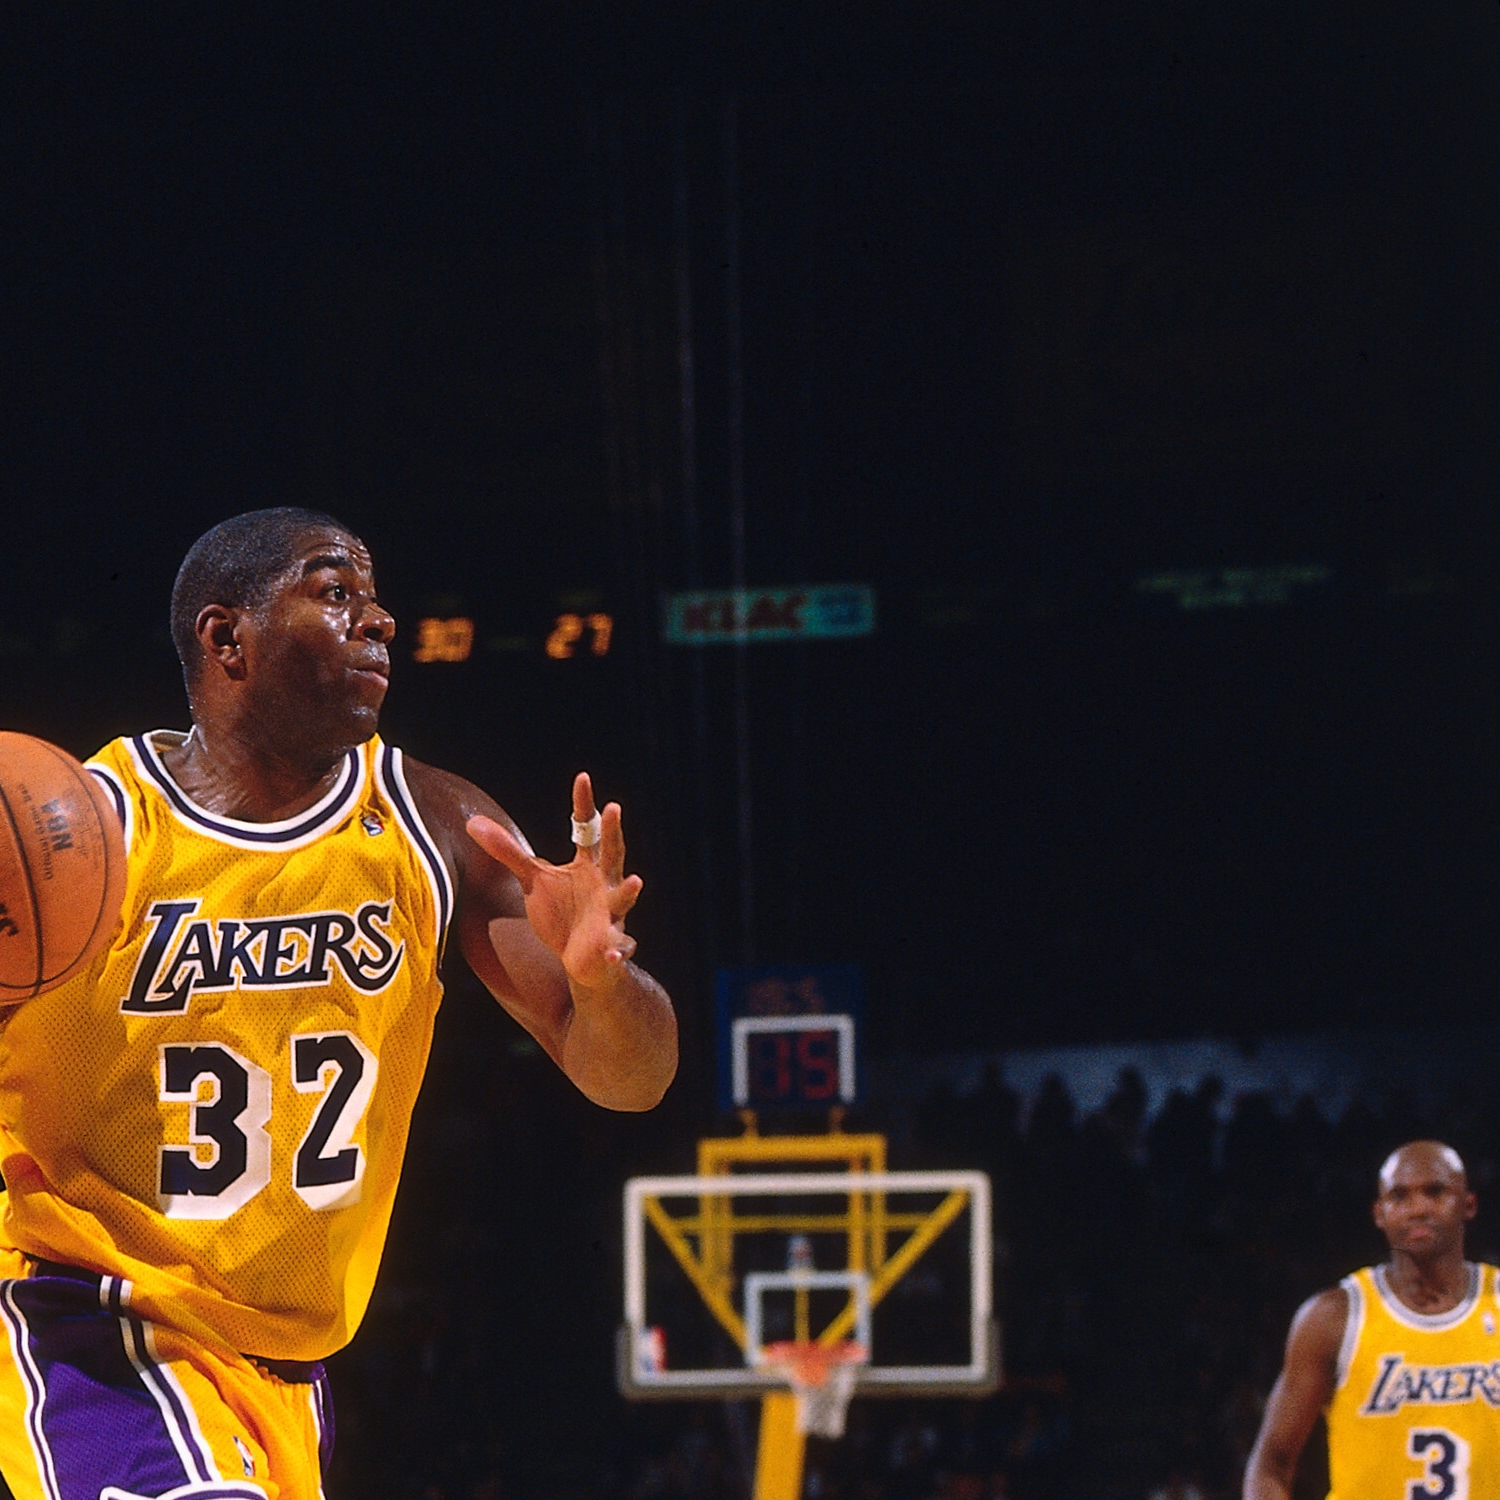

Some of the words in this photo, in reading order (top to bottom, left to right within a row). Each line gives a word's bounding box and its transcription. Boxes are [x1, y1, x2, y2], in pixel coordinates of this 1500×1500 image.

[546, 613, 614, 659] 27
[41, 798, 74, 852] NBA
[120, 898, 404, 1017] LAKERS
[157, 1030, 378, 1220] 32
